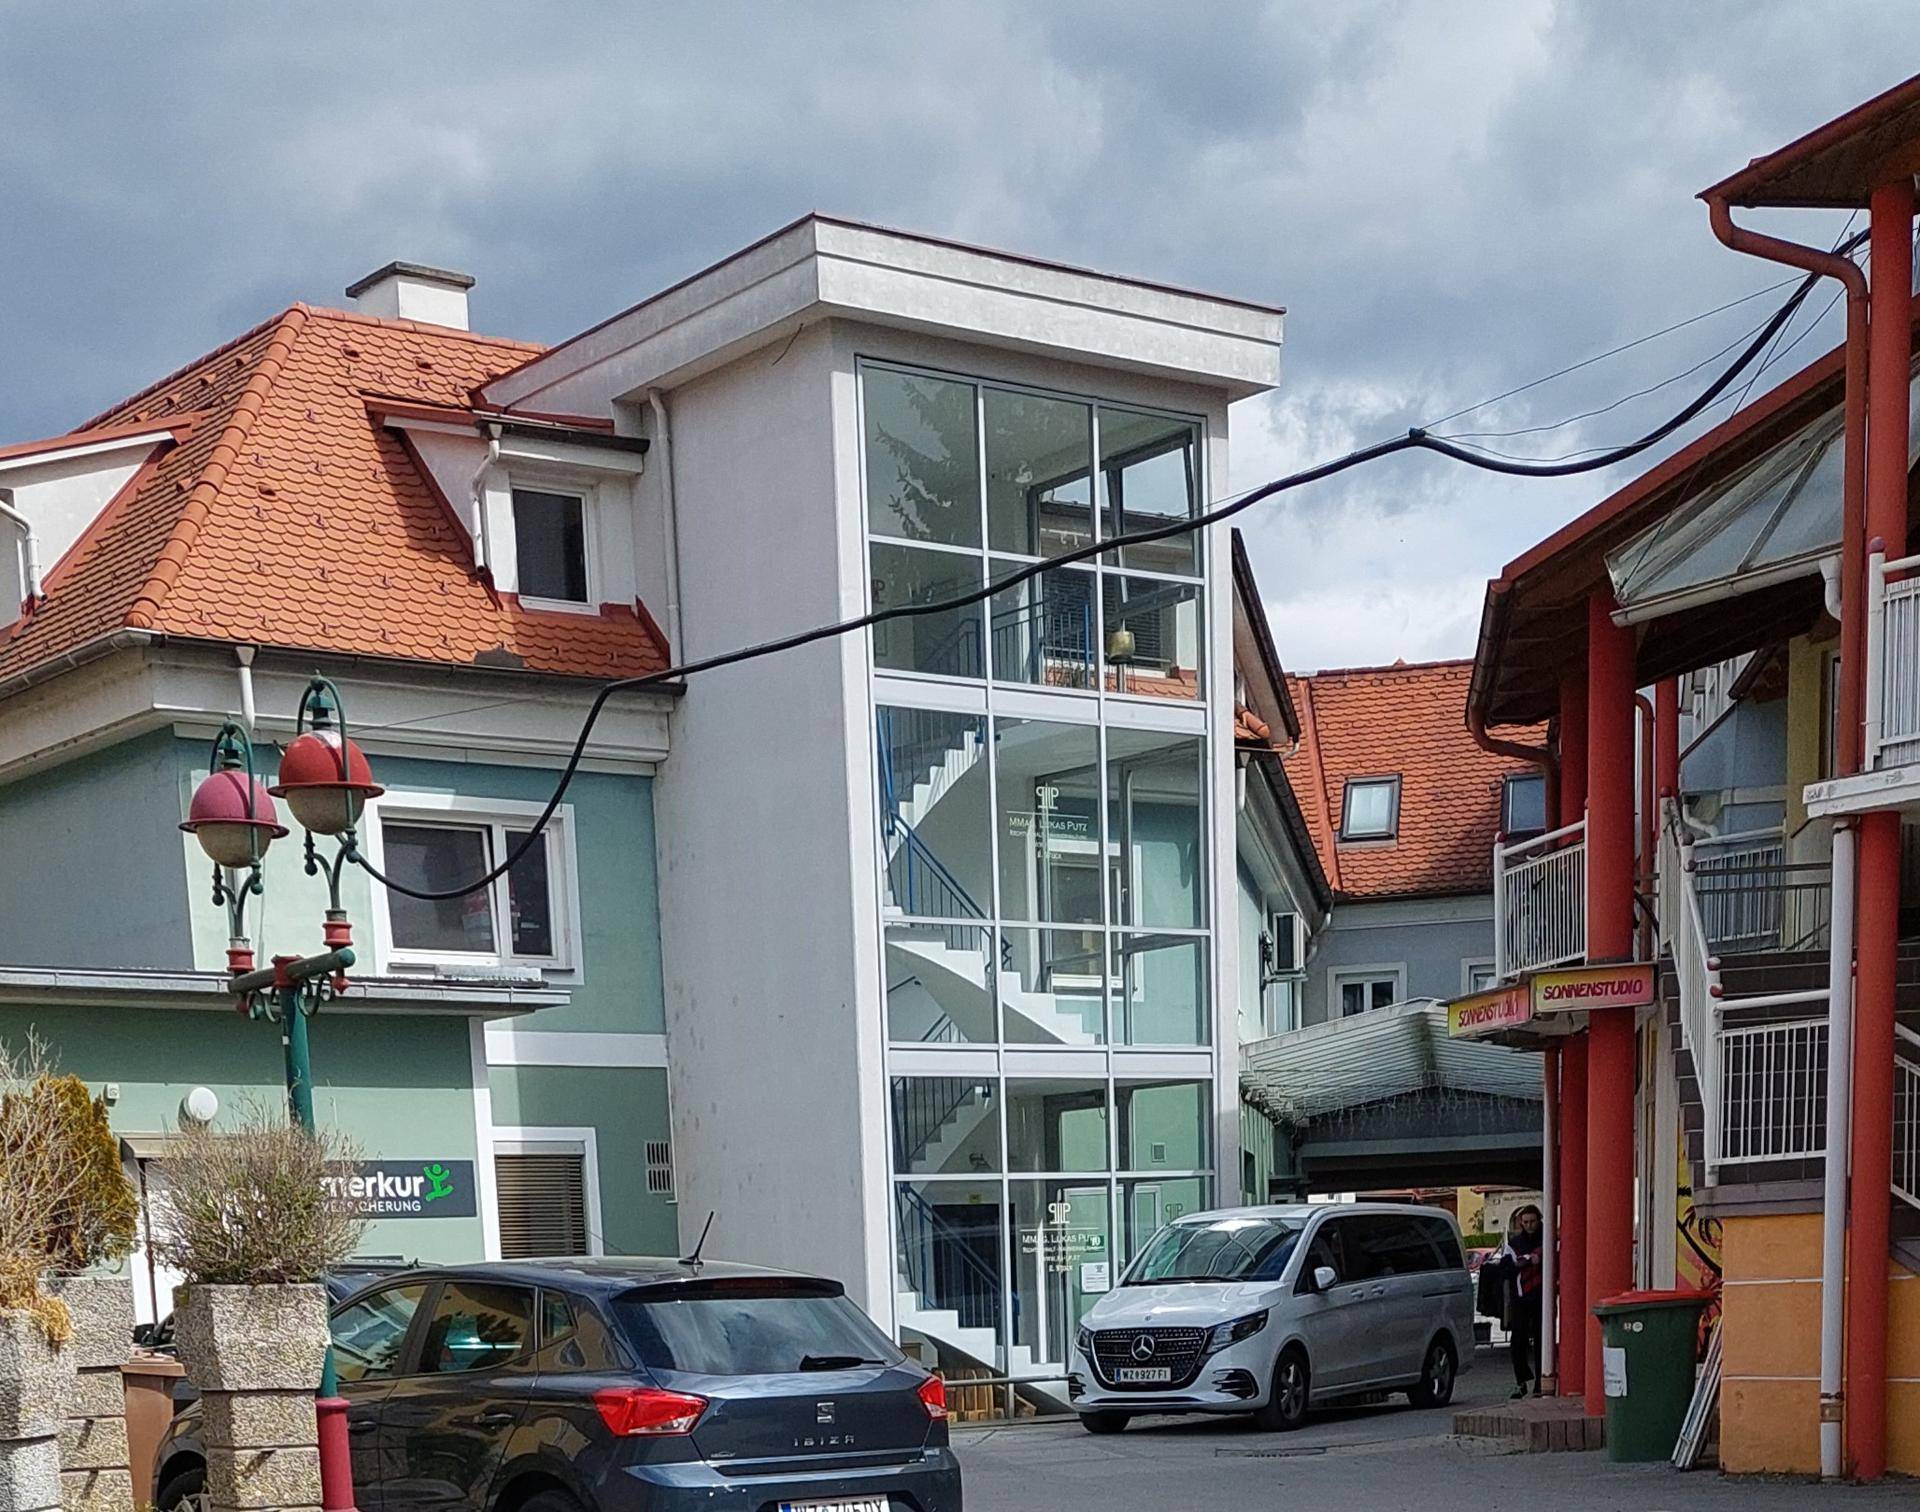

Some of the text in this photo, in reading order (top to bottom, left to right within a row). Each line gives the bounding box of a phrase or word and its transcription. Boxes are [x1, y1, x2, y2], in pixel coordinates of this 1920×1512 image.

[1066, 821, 1088, 832] PUTZ
[1543, 979, 1643, 1000] SONNENSTUDIO
[1458, 991, 1519, 1027] SONNENSTUDIO
[319, 1171, 425, 1198] merkur
[1122, 1370, 1134, 1380] WZ
[794, 1435, 855, 1447] IBIZA
